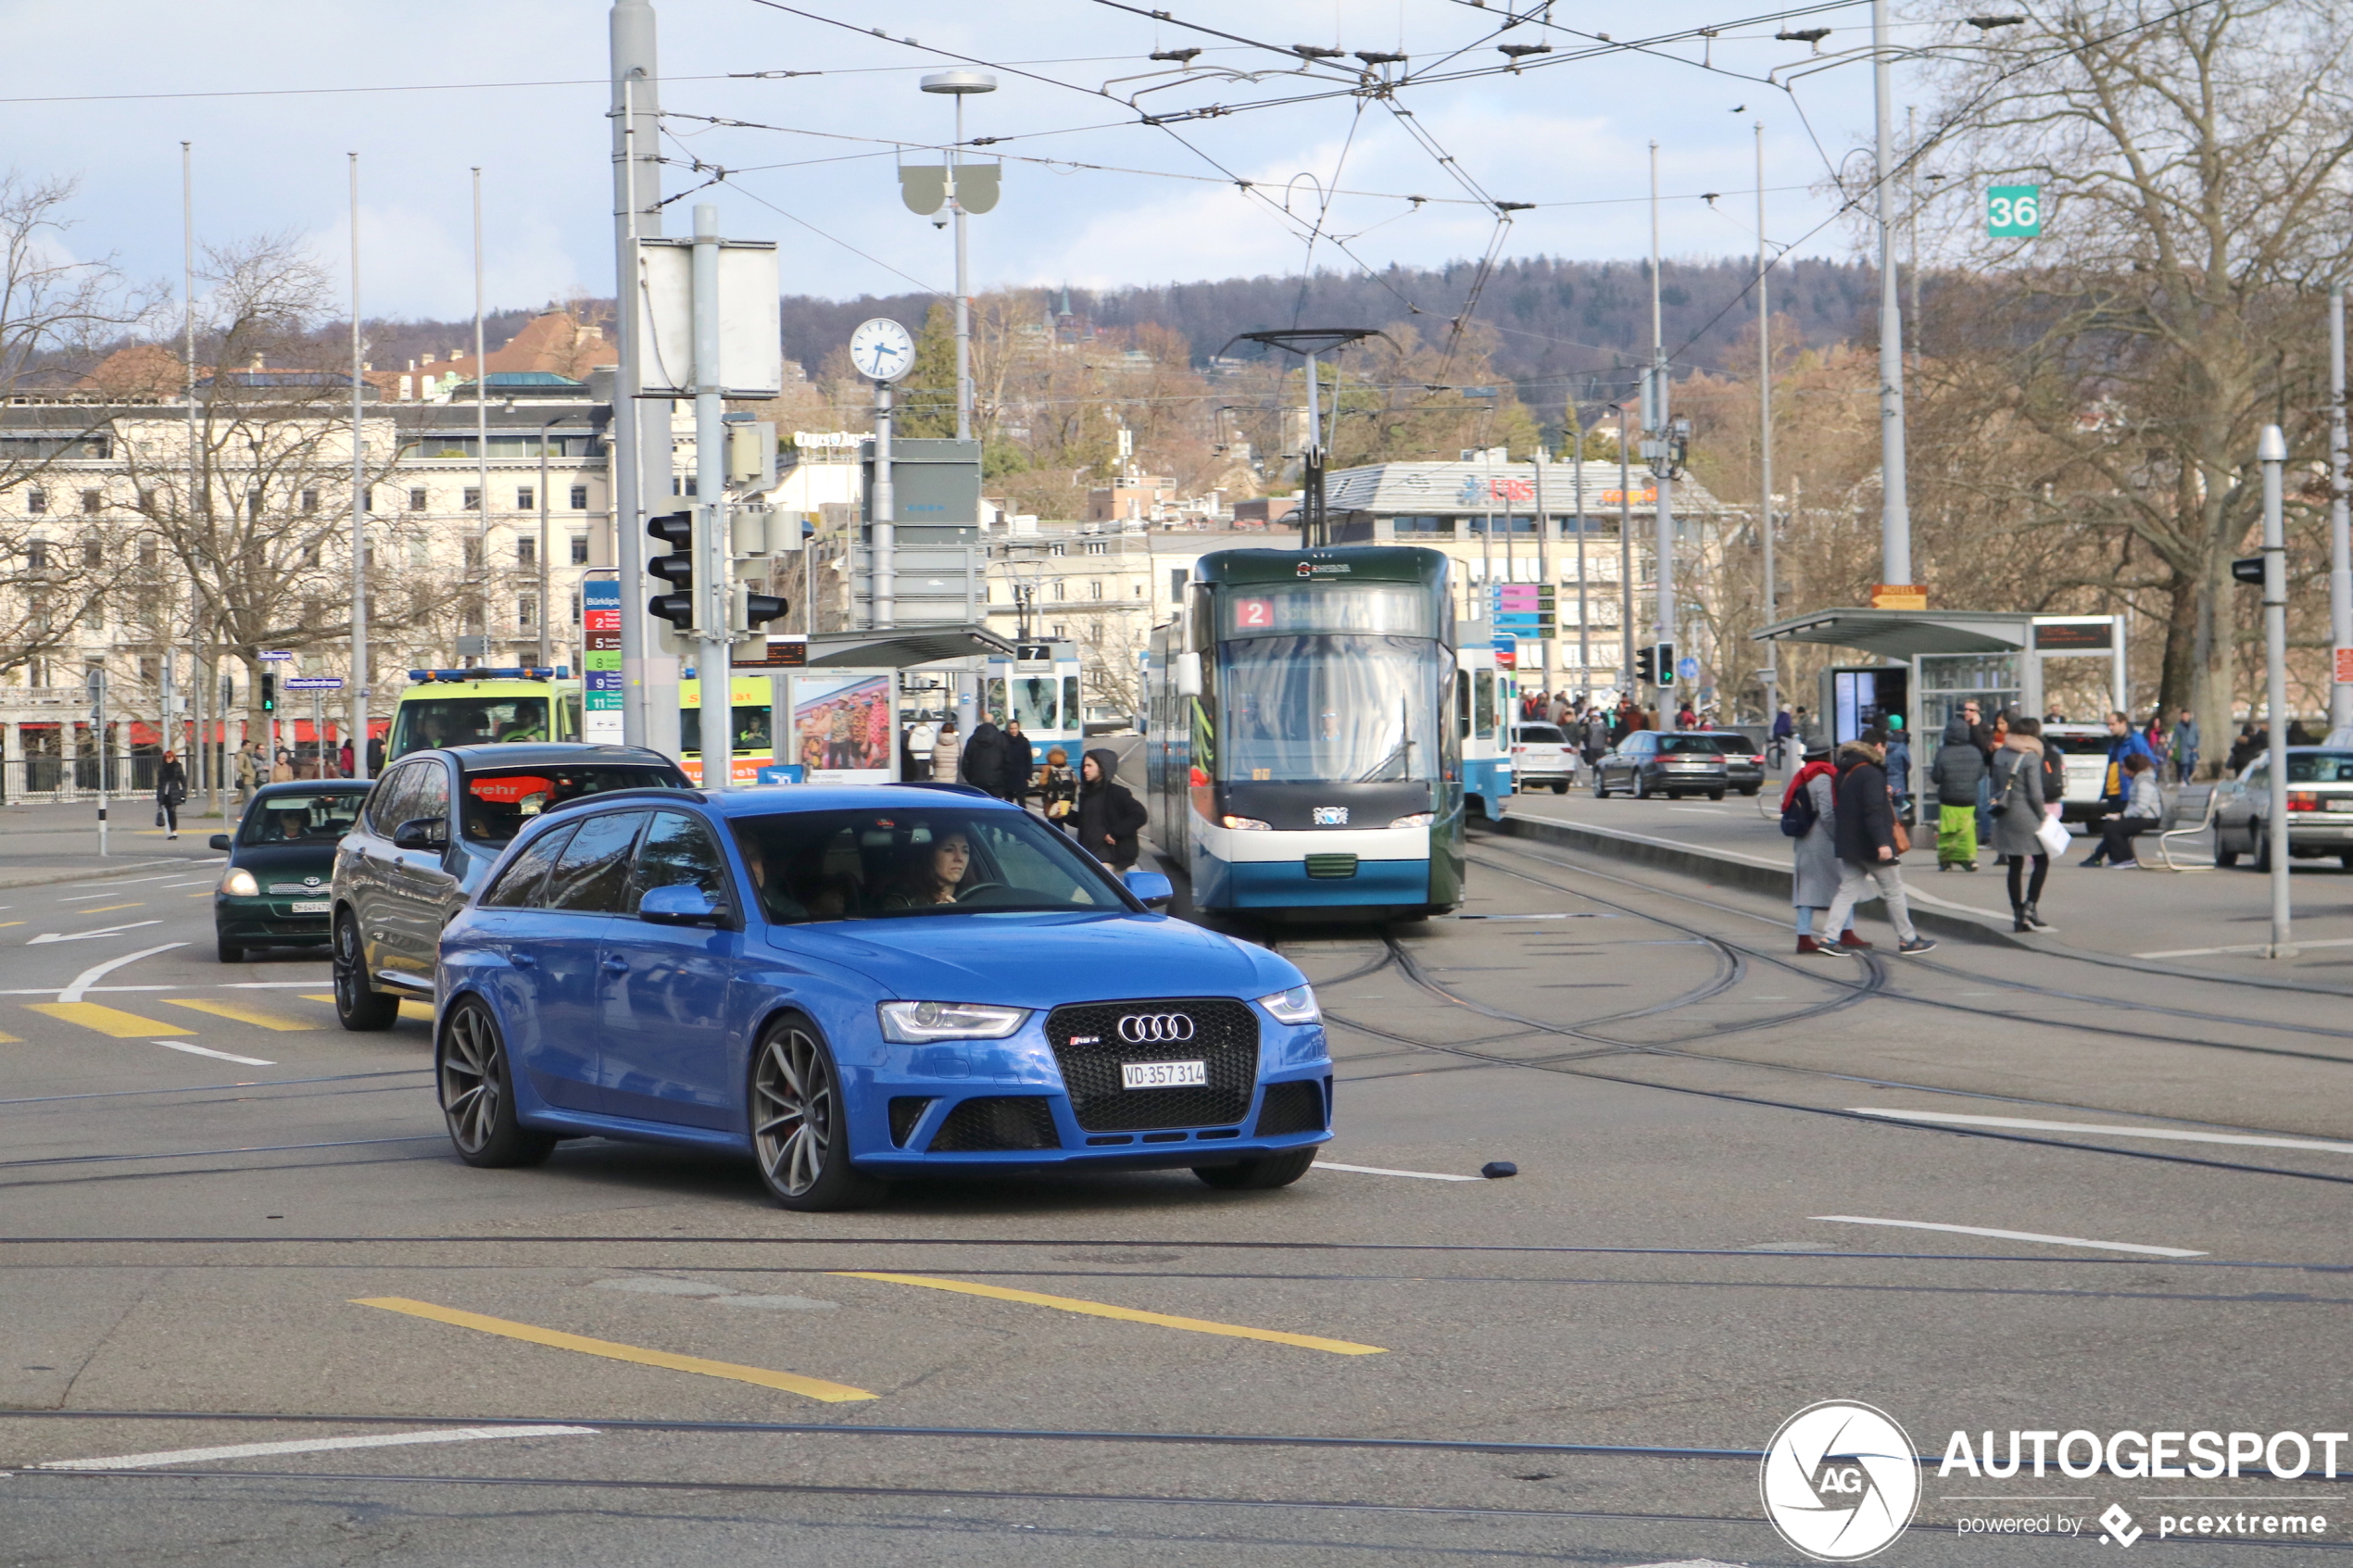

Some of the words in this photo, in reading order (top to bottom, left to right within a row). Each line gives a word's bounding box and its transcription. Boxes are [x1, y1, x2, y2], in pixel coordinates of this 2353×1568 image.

[1989, 196, 2038, 227] 36
[1490, 479, 1534, 501] UBS
[1602, 490, 1642, 506] cop
[1247, 603, 1265, 624] 2
[595, 618, 604, 629] 2
[595, 638, 604, 648] 5
[1028, 647, 1039, 659] 7
[596, 659, 604, 668] 8
[596, 679, 605, 689] 9
[594, 698, 606, 709] 11
[1177, 1063, 1204, 1084] 314
